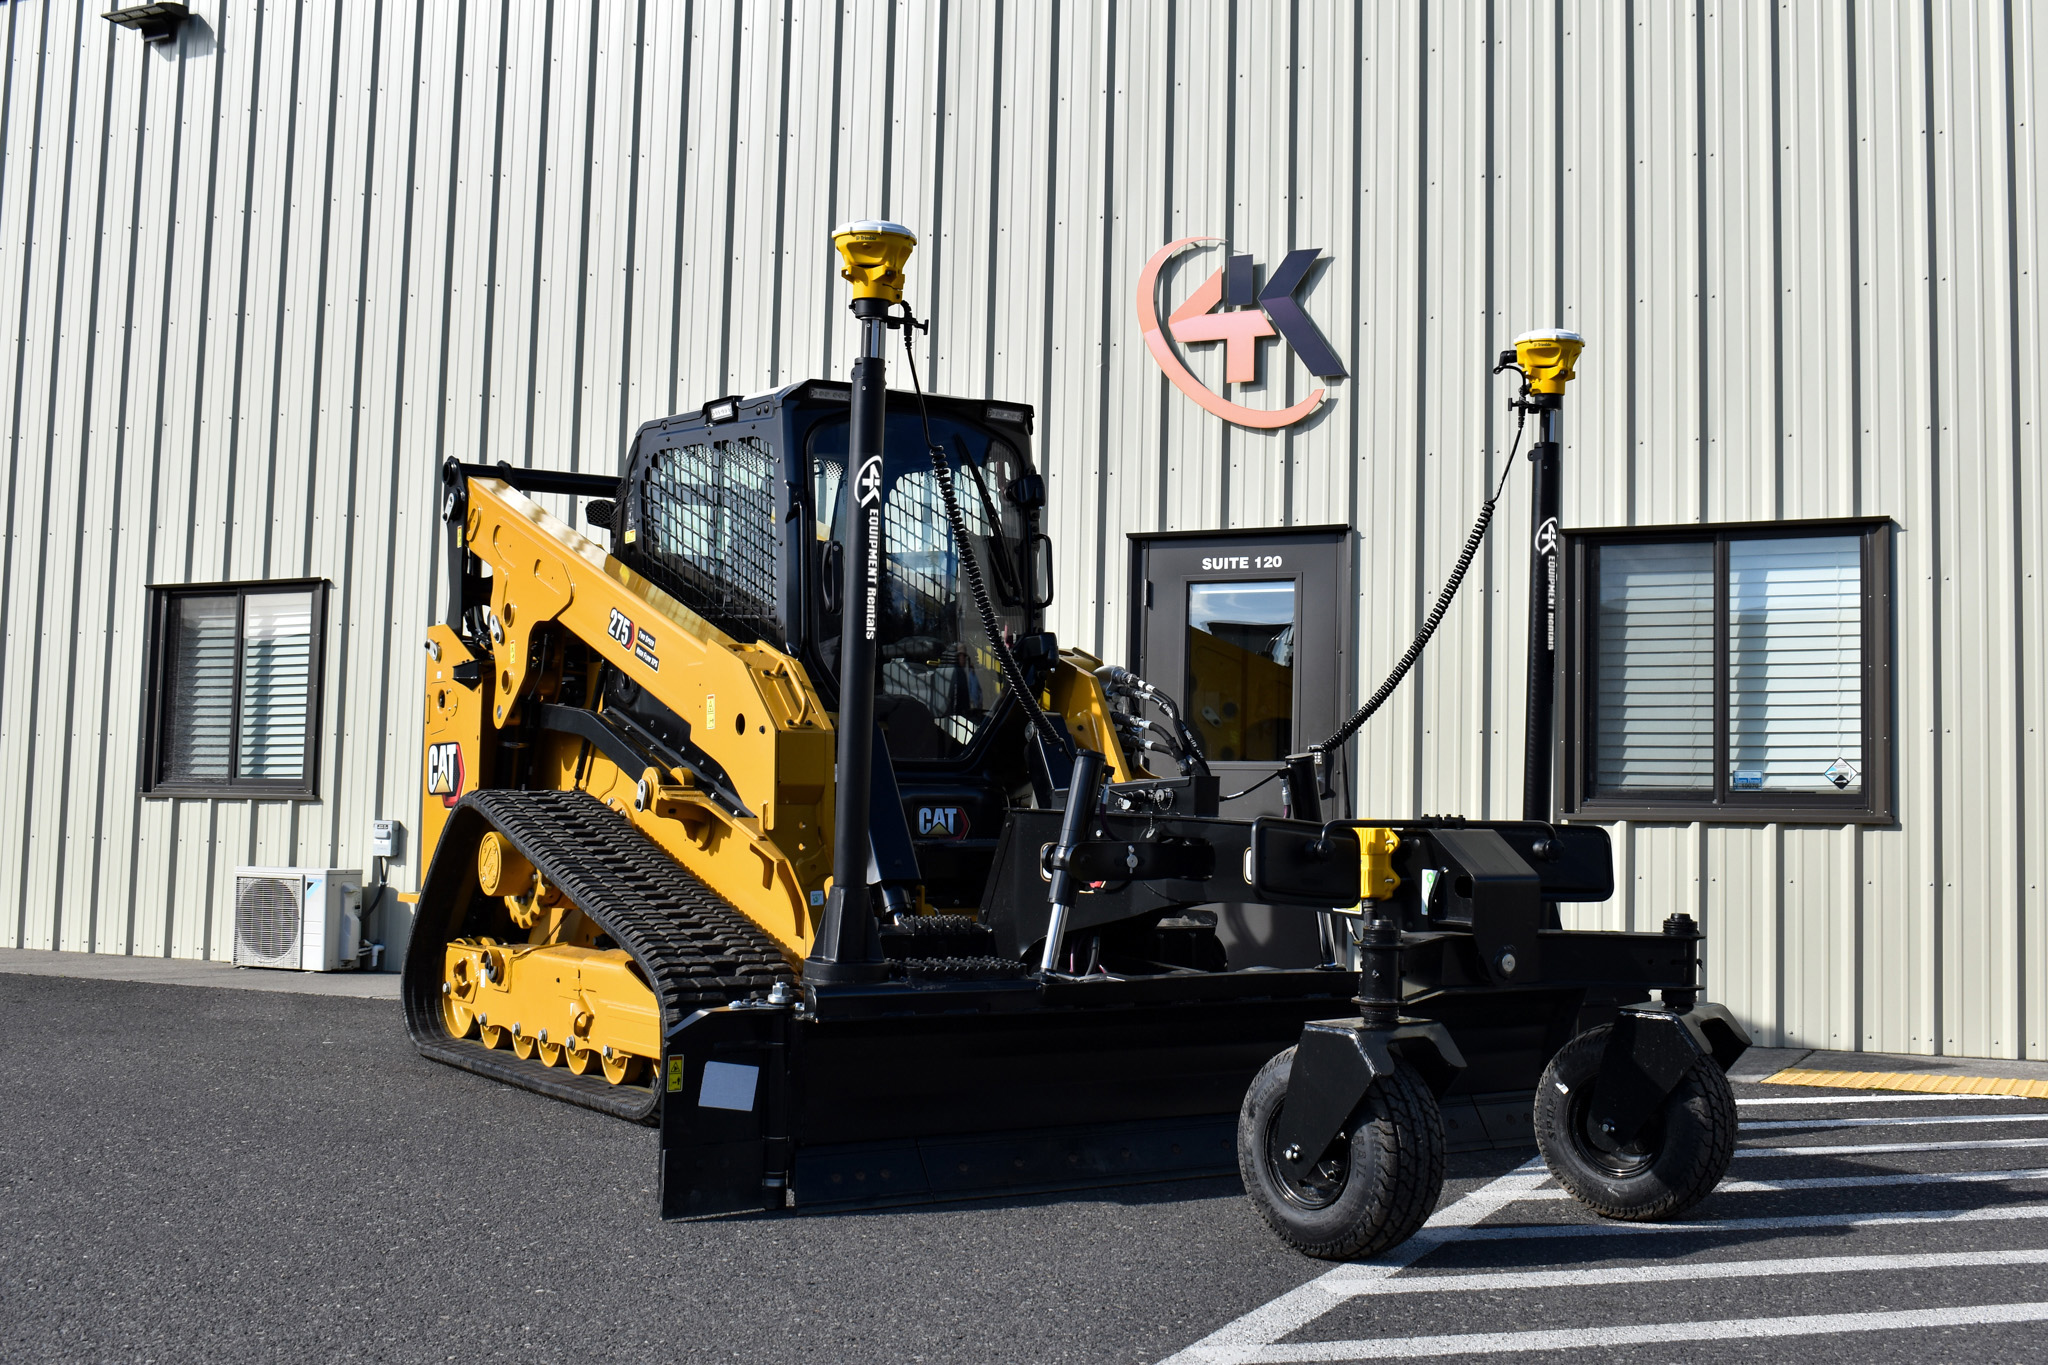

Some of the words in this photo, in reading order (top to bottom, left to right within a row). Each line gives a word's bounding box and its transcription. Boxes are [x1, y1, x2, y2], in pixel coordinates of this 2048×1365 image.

[868, 508, 879, 584] EQUIPMENT
[1201, 556, 1250, 570] SUITE
[1254, 555, 1283, 569] 120
[608, 608, 630, 645] 275
[865, 587, 877, 640] Rentals
[428, 743, 457, 794] CAT
[918, 807, 958, 835] CAT
[1352, 1129, 1367, 1179] RAIL
